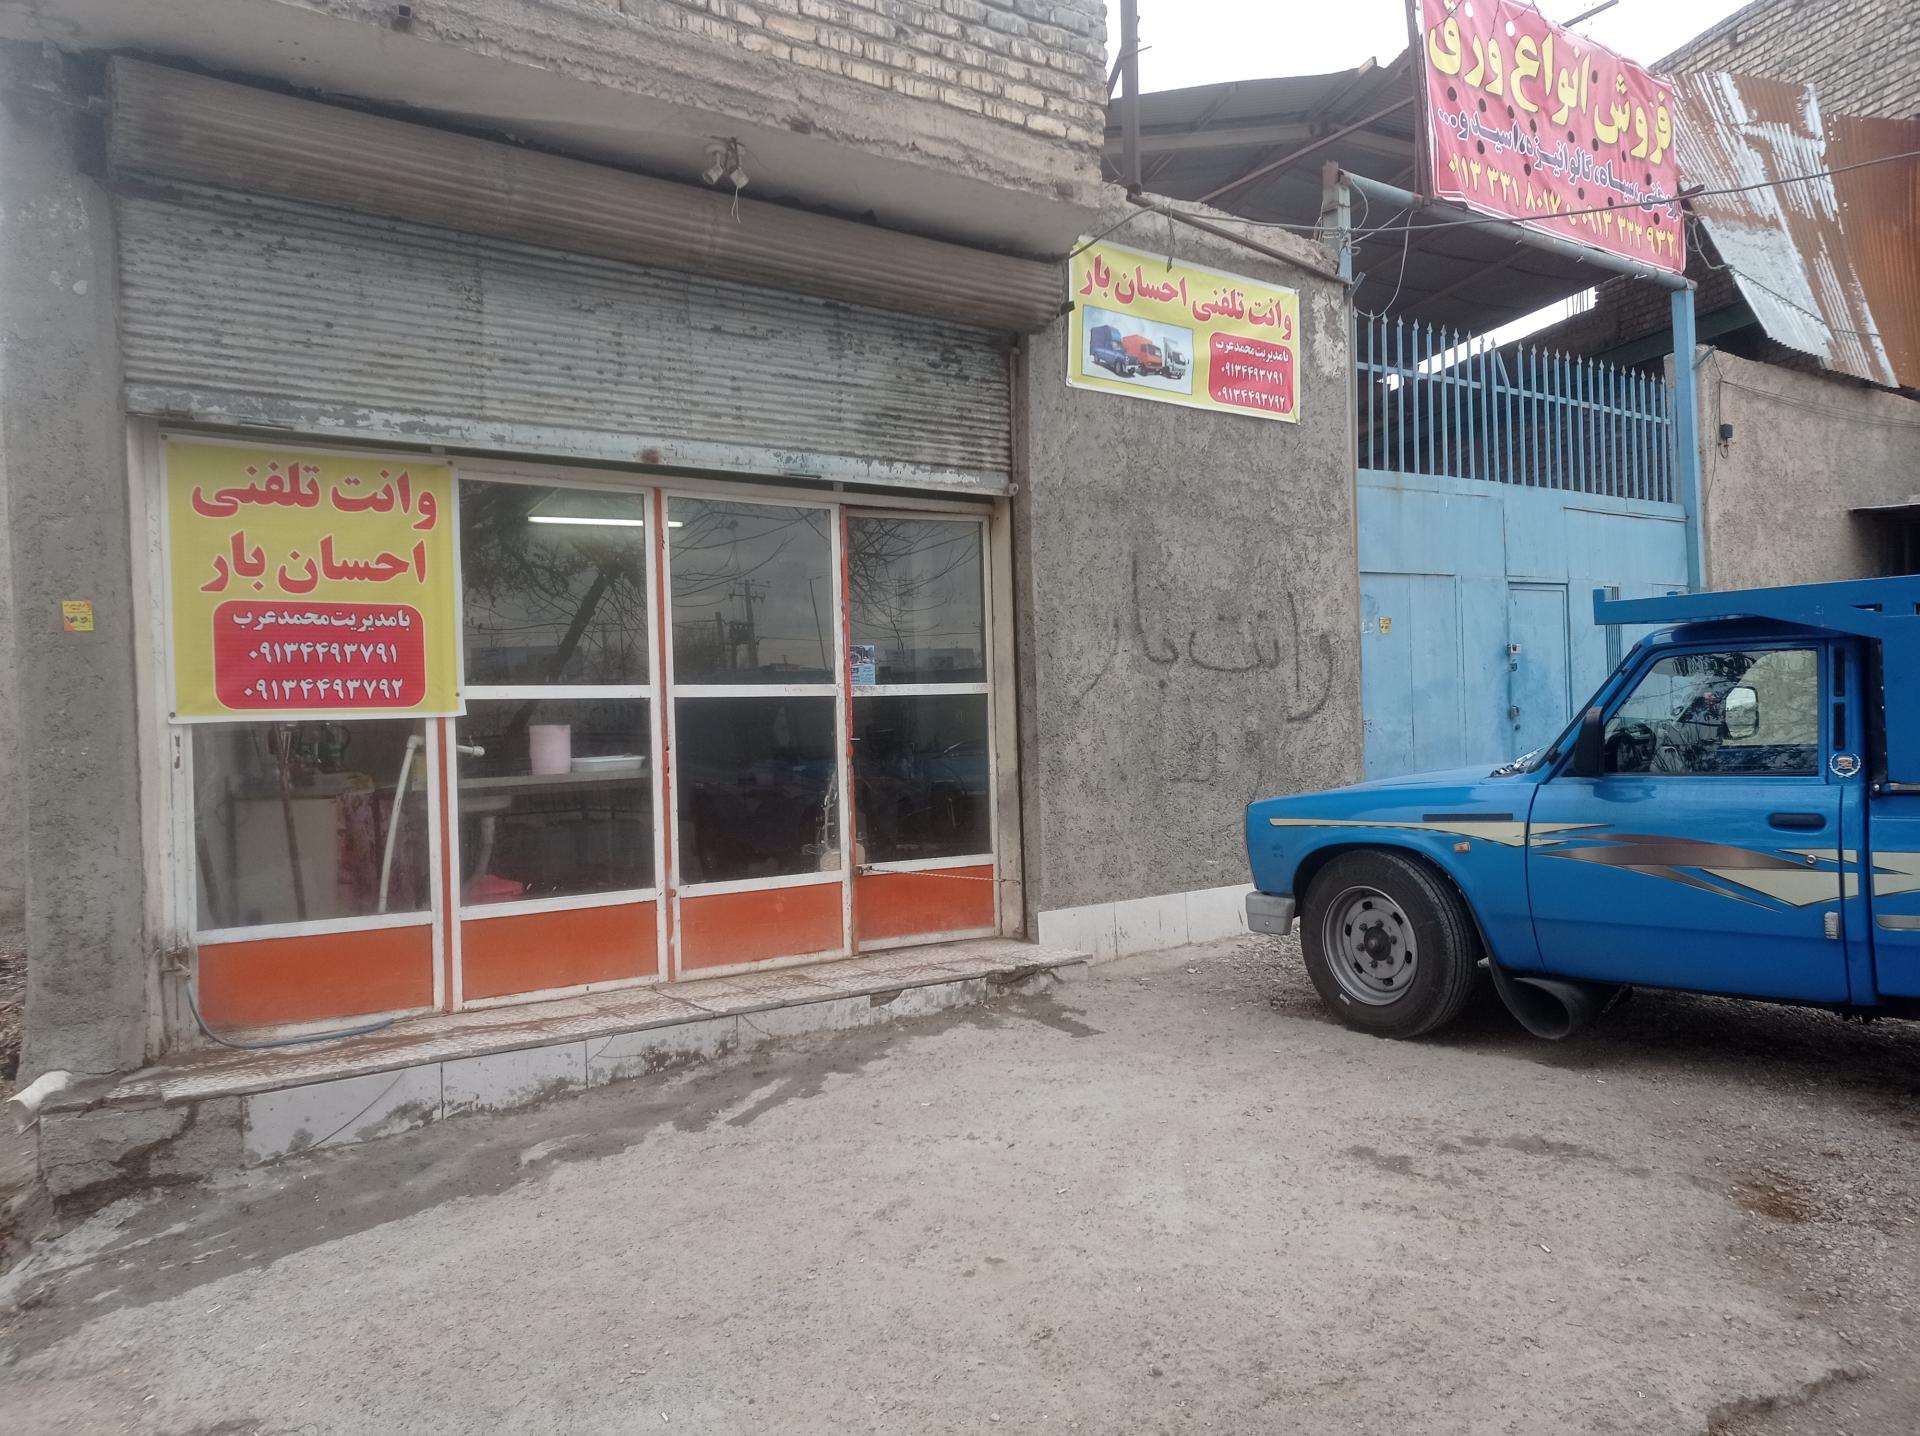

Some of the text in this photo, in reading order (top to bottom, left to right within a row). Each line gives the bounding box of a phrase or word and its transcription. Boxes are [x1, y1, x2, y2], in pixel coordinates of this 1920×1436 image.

[1429, 0, 1673, 164] فروش انواع ورق
[1079, 254, 1293, 341] وانت تلفنی احسان بار
[1221, 361, 1283, 386] ۰۹۱۳۴۴۹۳۷۹۱
[1217, 386, 1285, 410] ۰۹۱۳۴۴۹۳۷۹۲
[191, 461, 439, 530] وانت تلفنی
[200, 529, 428, 595] احسان بار
[249, 641, 398, 664] ۰۹۱۳۴۴۹۳۷۹۱
[244, 678, 403, 701] ۰۹۱۳۴۴۹۳۷۹۲
